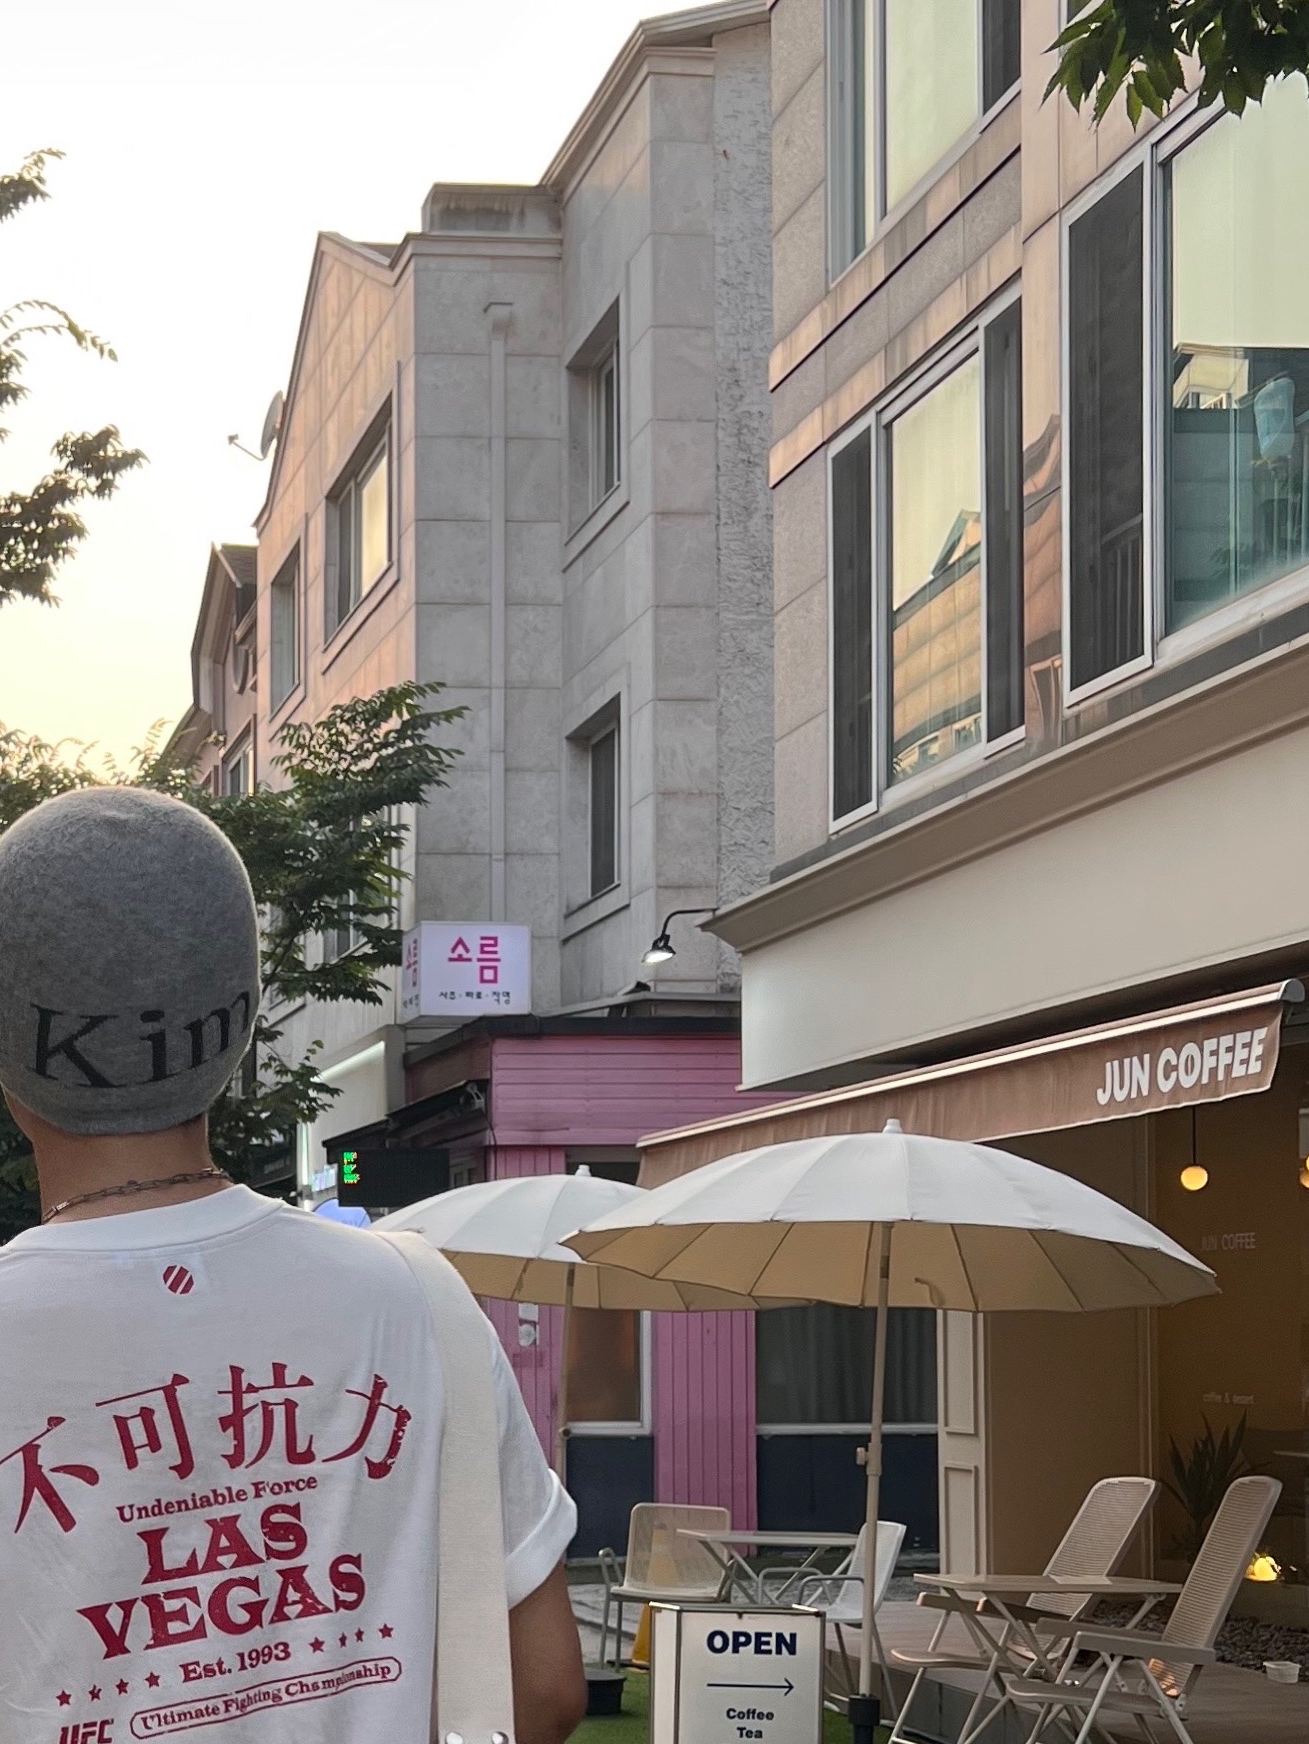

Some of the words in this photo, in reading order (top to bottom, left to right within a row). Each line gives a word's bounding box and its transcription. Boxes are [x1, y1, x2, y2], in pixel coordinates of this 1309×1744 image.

[447, 936, 501, 984] 소름
[1096, 1053, 1150, 1106] JUN
[1157, 1027, 1268, 1093] COFFEE
[1221, 1232, 1256, 1250] COFFEE
[117, 1484, 249, 1524] Undeniable
[252, 1474, 319, 1500] Force
[136, 1502, 309, 1585] LAS
[77, 1553, 367, 1660] VEGAS
[179, 1658, 233, 1684] Est.
[237, 1641, 292, 1673] 1993
[706, 1630, 797, 1655] OPEN
[140, 1702, 222, 1732] Ultimate
[222, 1685, 285, 1715] Fighting
[726, 1708, 774, 1721] Coffee
[737, 1727, 763, 1739] Tea
